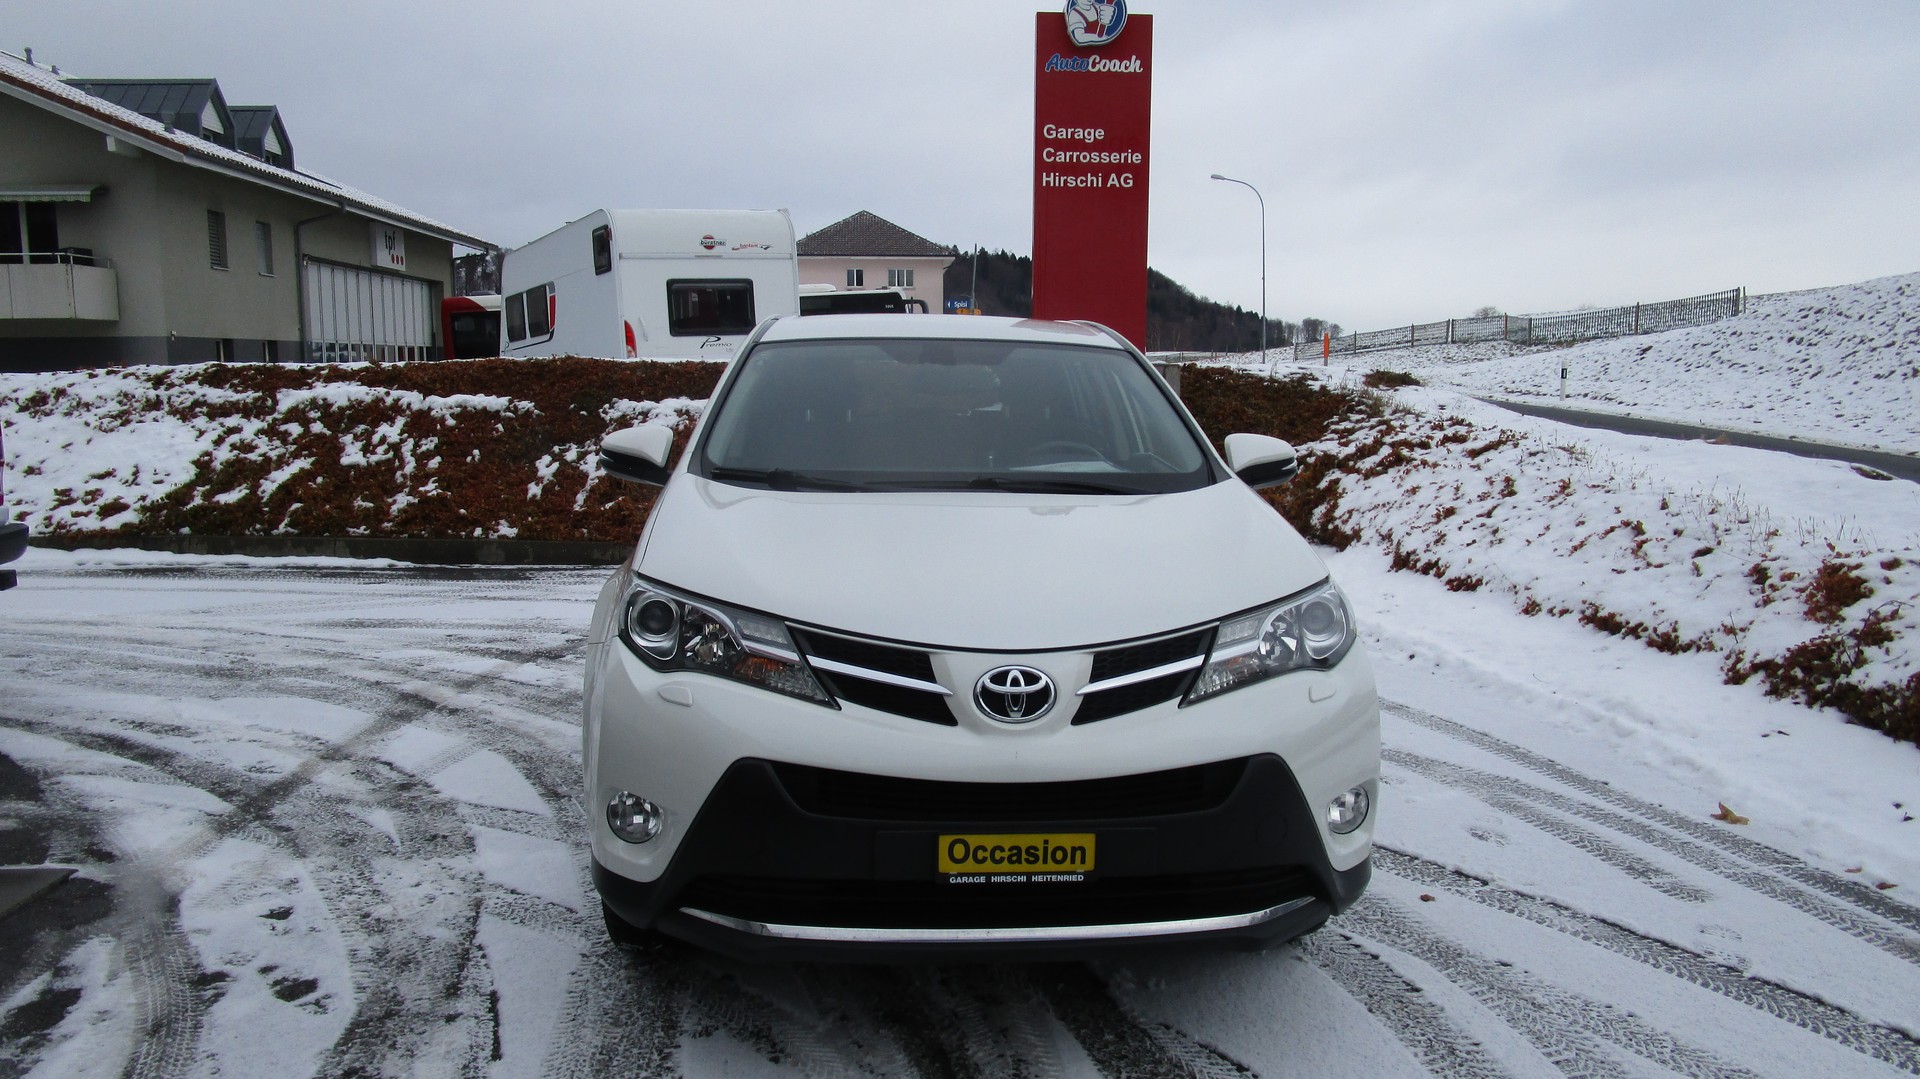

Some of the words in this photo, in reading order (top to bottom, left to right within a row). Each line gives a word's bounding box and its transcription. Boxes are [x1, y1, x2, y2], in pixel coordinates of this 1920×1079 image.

[1045, 53, 1143, 73] AutoCoach
[1043, 124, 1105, 143] Garage
[1042, 147, 1142, 164] Carrosserie
[1042, 172, 1102, 187] Hirschi
[1106, 173, 1134, 188] AG
[947, 838, 1087, 865] Occasion
[949, 876, 986, 884] GARAGE
[991, 875, 1027, 883] HIRSCHI
[1031, 874, 1085, 882] HEITENRIED
